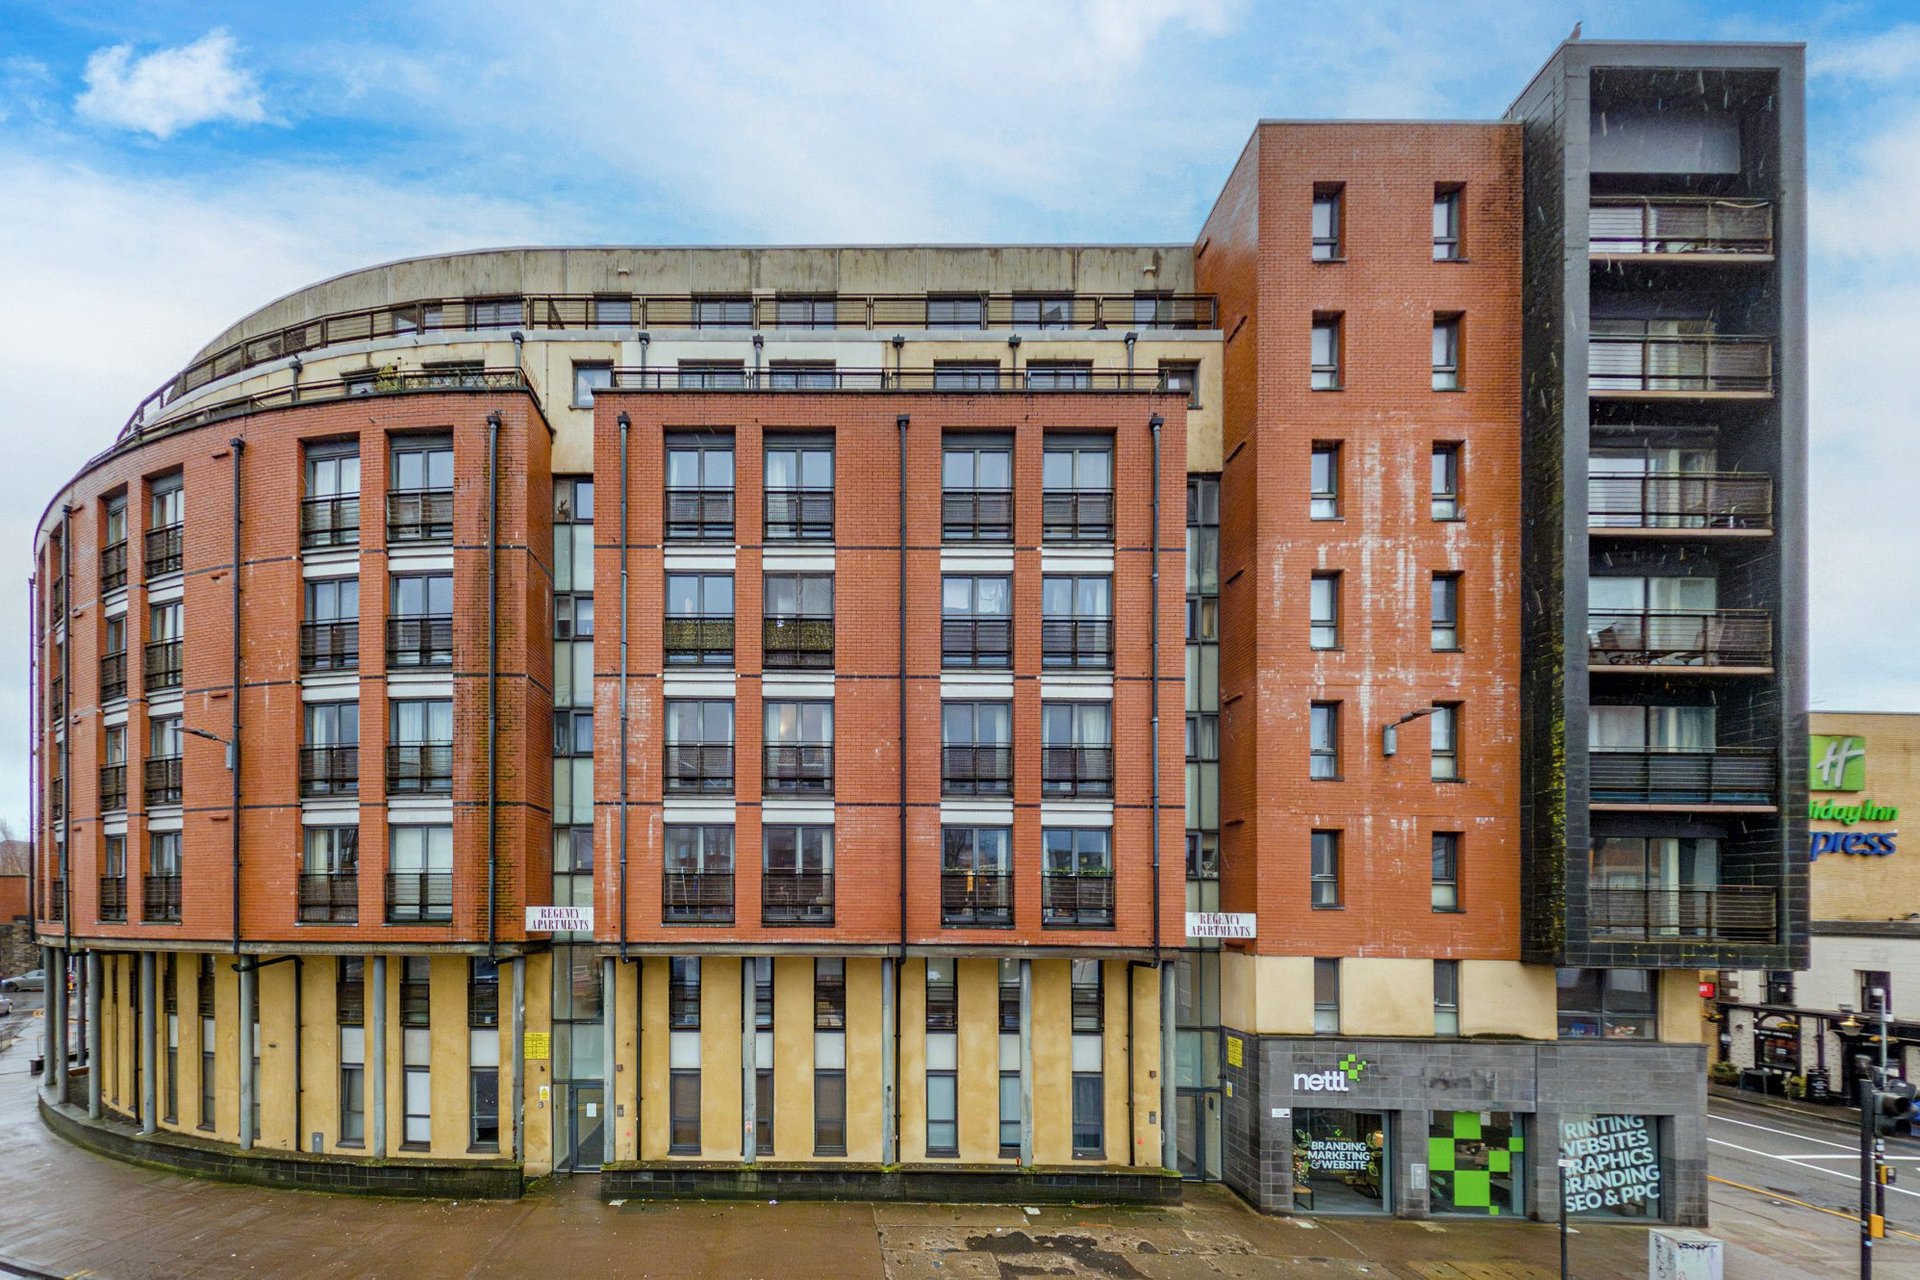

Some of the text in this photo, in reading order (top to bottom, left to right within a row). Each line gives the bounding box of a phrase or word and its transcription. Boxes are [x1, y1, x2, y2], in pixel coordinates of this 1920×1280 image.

[1809, 799, 1899, 826] liday Inn
[1809, 831, 1898, 862] press
[540, 908, 580, 919] REGENCY
[1200, 913, 1241, 925] REGENCY
[532, 919, 589, 931] APARTMENTS
[1192, 925, 1251, 937] APARTMENTS
[1293, 1071, 1350, 1092] nettl
[1564, 1115, 1645, 1139] RINTING
[1311, 1141, 1367, 1151] BRANDING
[1307, 1151, 1371, 1161] MARKETING
[1311, 1160, 1367, 1170] & WEBSITE
[1565, 1182, 1660, 1212] SEO & PPC
